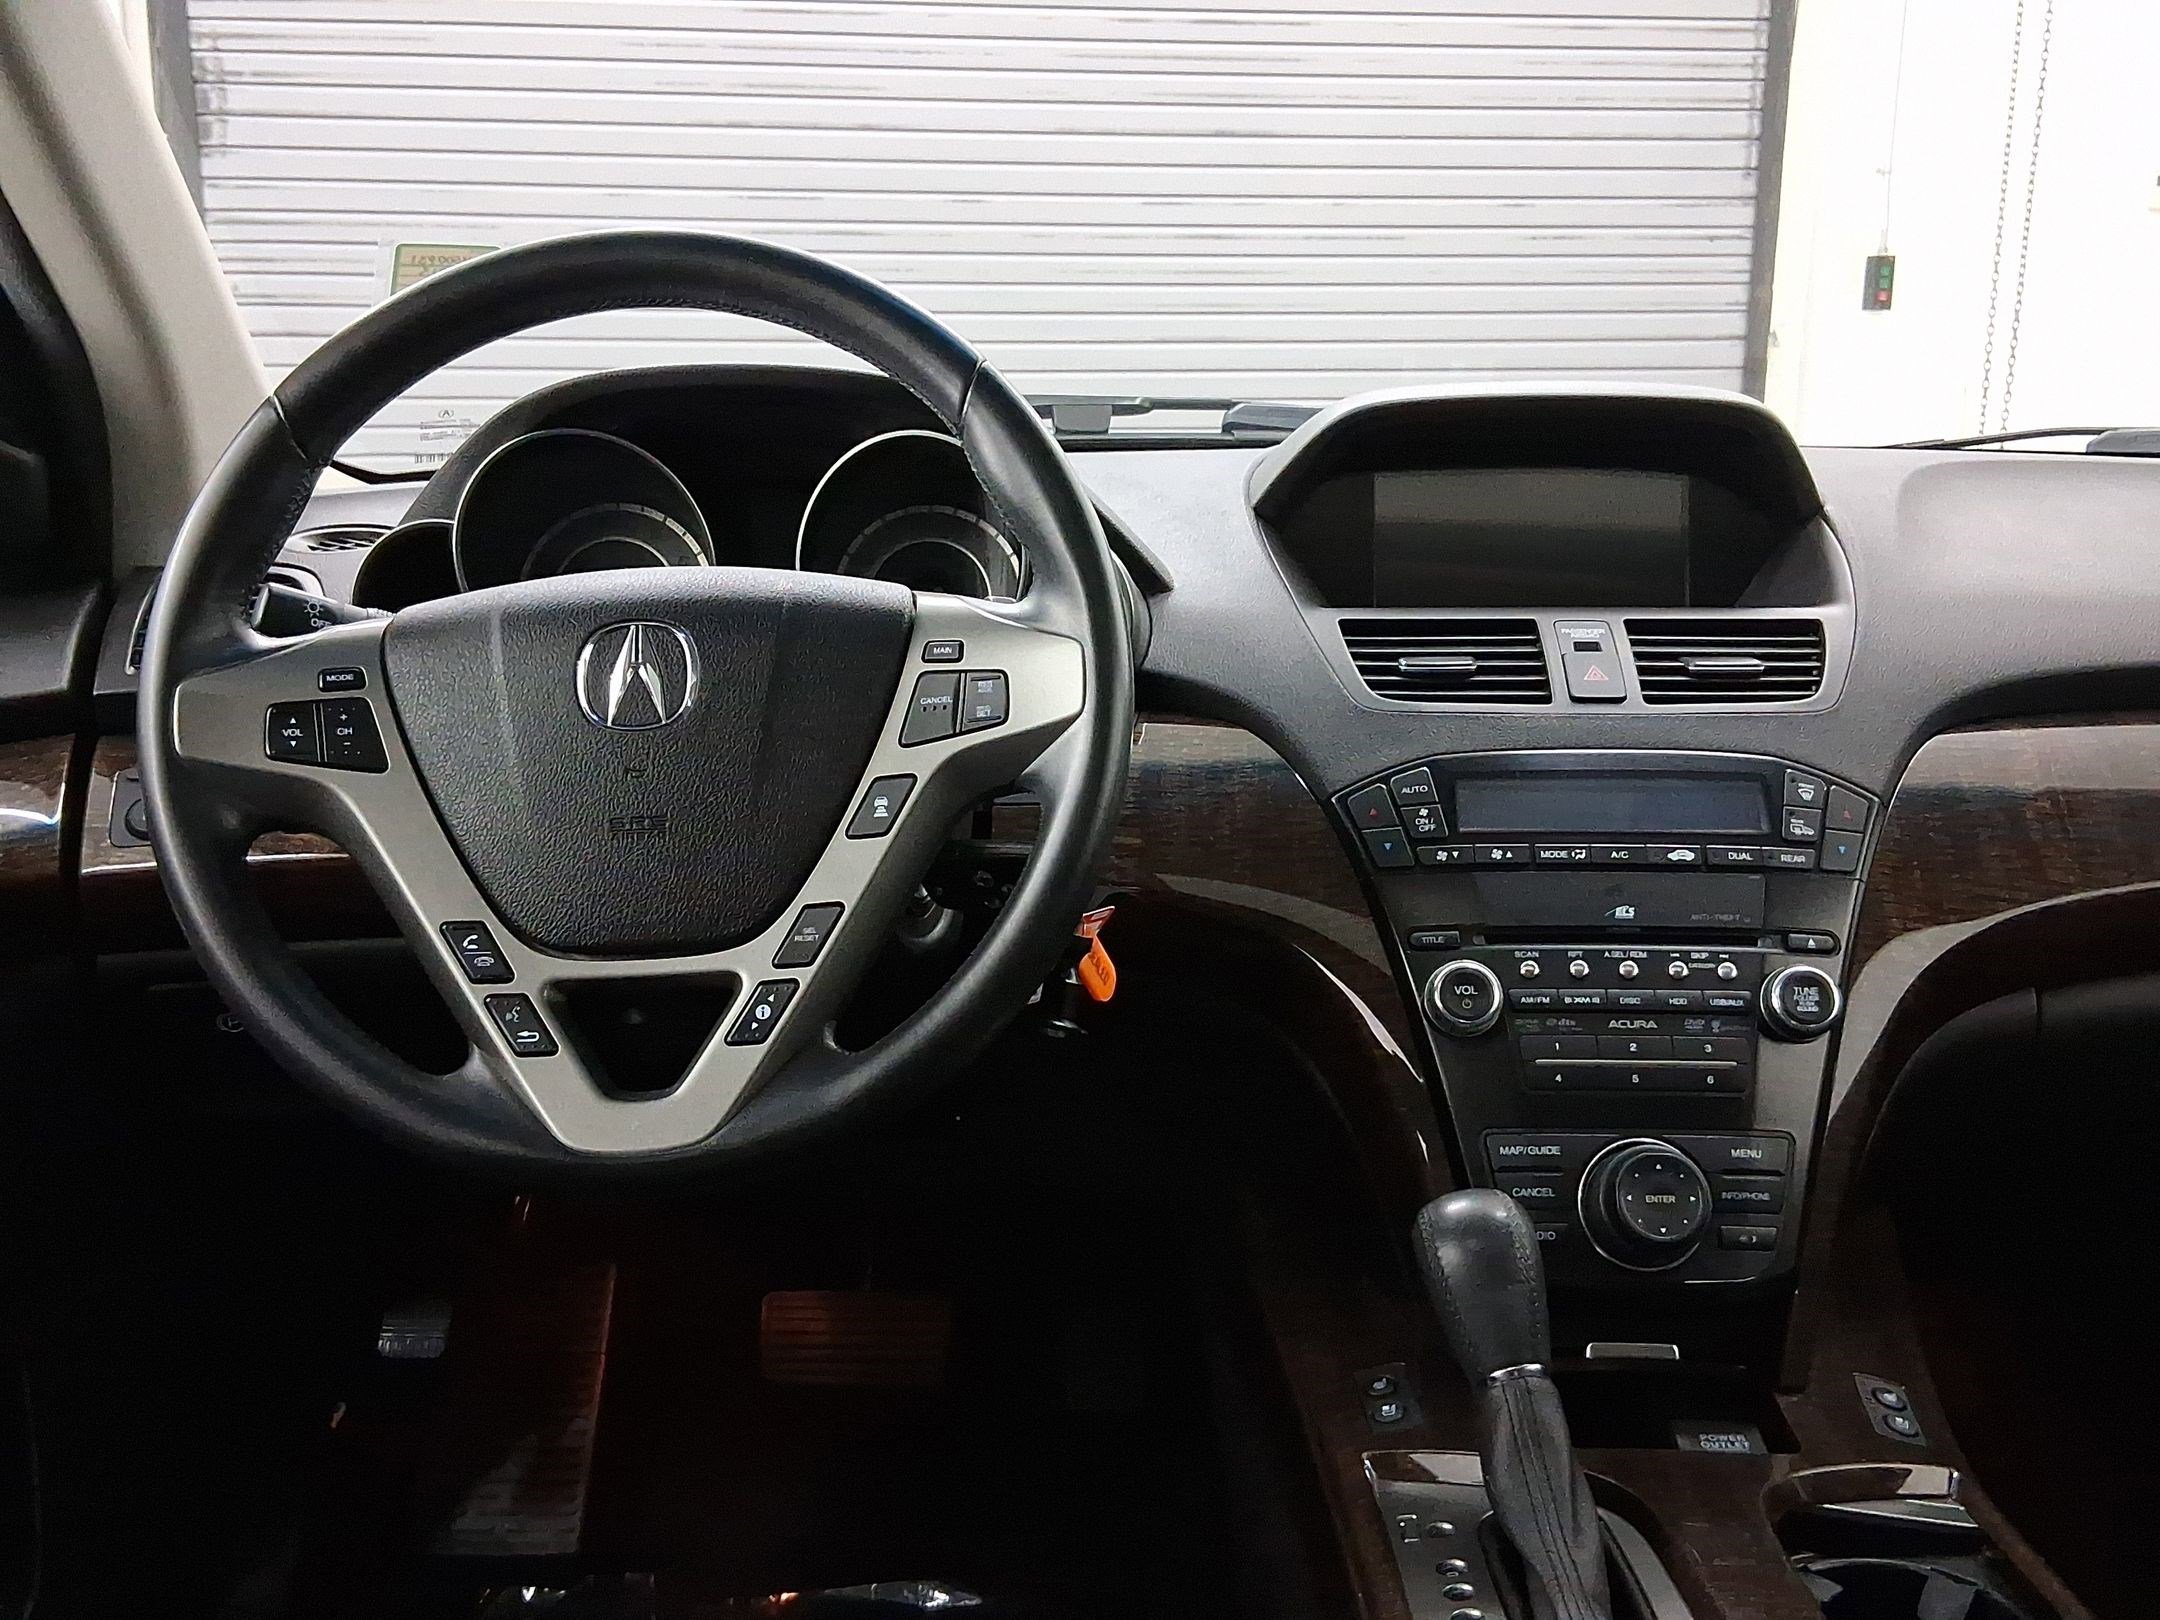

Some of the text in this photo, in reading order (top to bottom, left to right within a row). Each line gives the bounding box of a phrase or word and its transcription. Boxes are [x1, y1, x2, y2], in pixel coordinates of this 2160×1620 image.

[326, 674, 354, 682] MODE
[920, 696, 952, 705] CANCEL
[282, 728, 303, 737] VOL
[336, 727, 353, 736] CH
[1401, 785, 1428, 794] AUTO
[1540, 851, 1568, 859] MODE
[1611, 851, 1629, 859] A/C
[1728, 852, 1754, 861] DUAL
[1781, 854, 1805, 863] REAR
[794, 934, 820, 942] RESET
[1421, 936, 1445, 944] TITLE
[1454, 985, 1478, 995] VOL
[1520, 996, 1550, 1004] AM/FM
[1608, 1019, 1658, 1029] ACURA
[1554, 1042, 1559, 1051] 1
[1629, 1042, 1638, 1052] 2
[1703, 1044, 1712, 1053] 3
[1554, 1073, 1562, 1082] 4
[1631, 1074, 1640, 1083] 5
[1706, 1075, 1715, 1084] 6
[1499, 1146, 1561, 1155] MAP/GUIDE
[1731, 1149, 1762, 1158] MENU
[1512, 1187, 1555, 1197] CANCEL
[1645, 1195, 1676, 1203] ENTER
[1700, 1441, 1750, 1449] OUTLET
